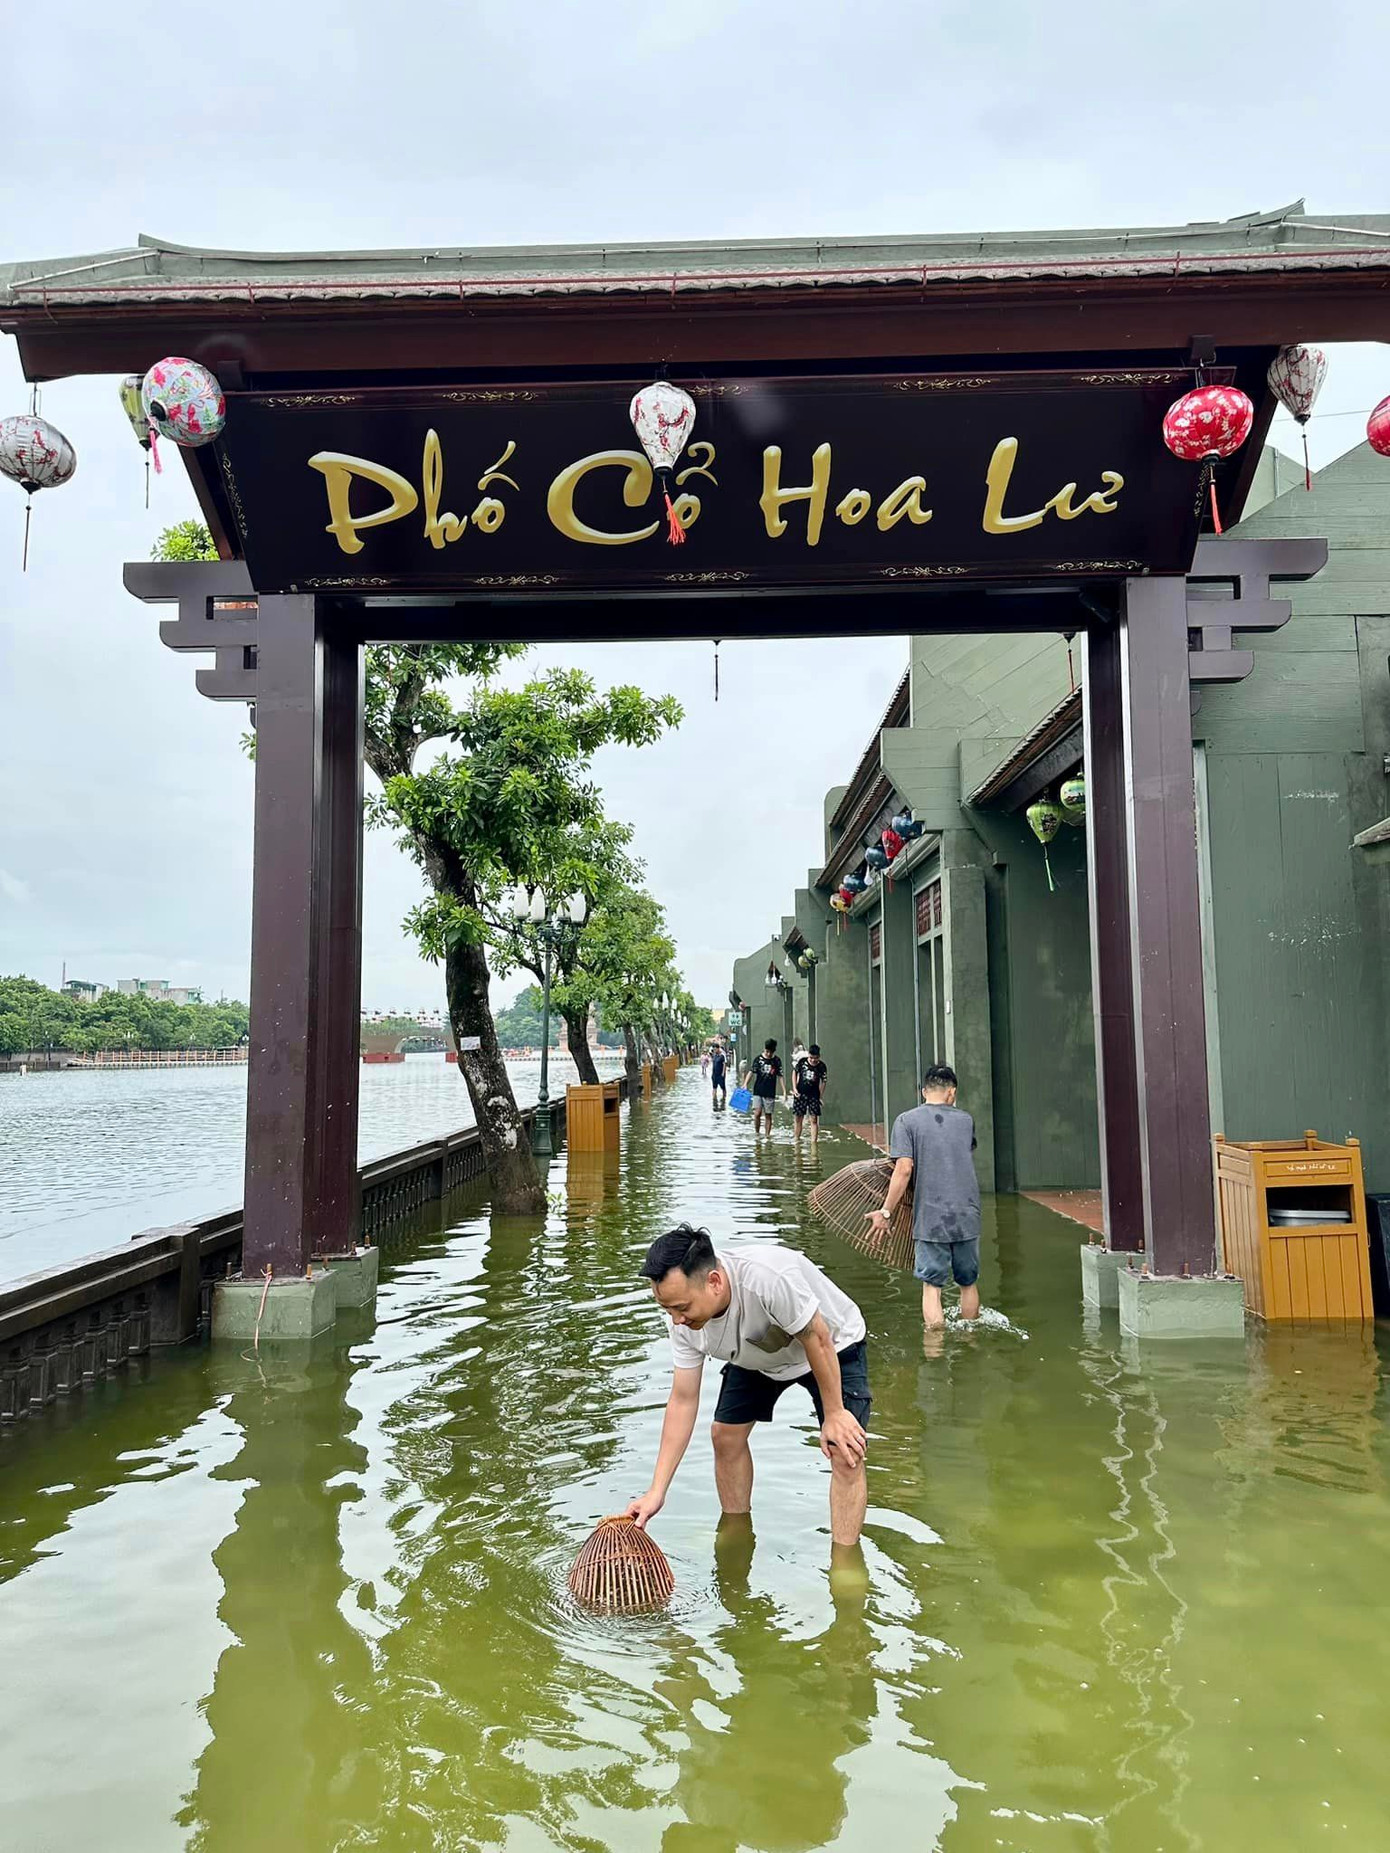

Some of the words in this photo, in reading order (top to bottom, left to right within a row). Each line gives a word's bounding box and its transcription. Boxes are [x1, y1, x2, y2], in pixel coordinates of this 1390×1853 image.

[308, 428, 520, 555] Phố
[547, 441, 719, 546] Cổ
[759, 442, 933, 547] Hoa
[982, 436, 1125, 535] Lư
